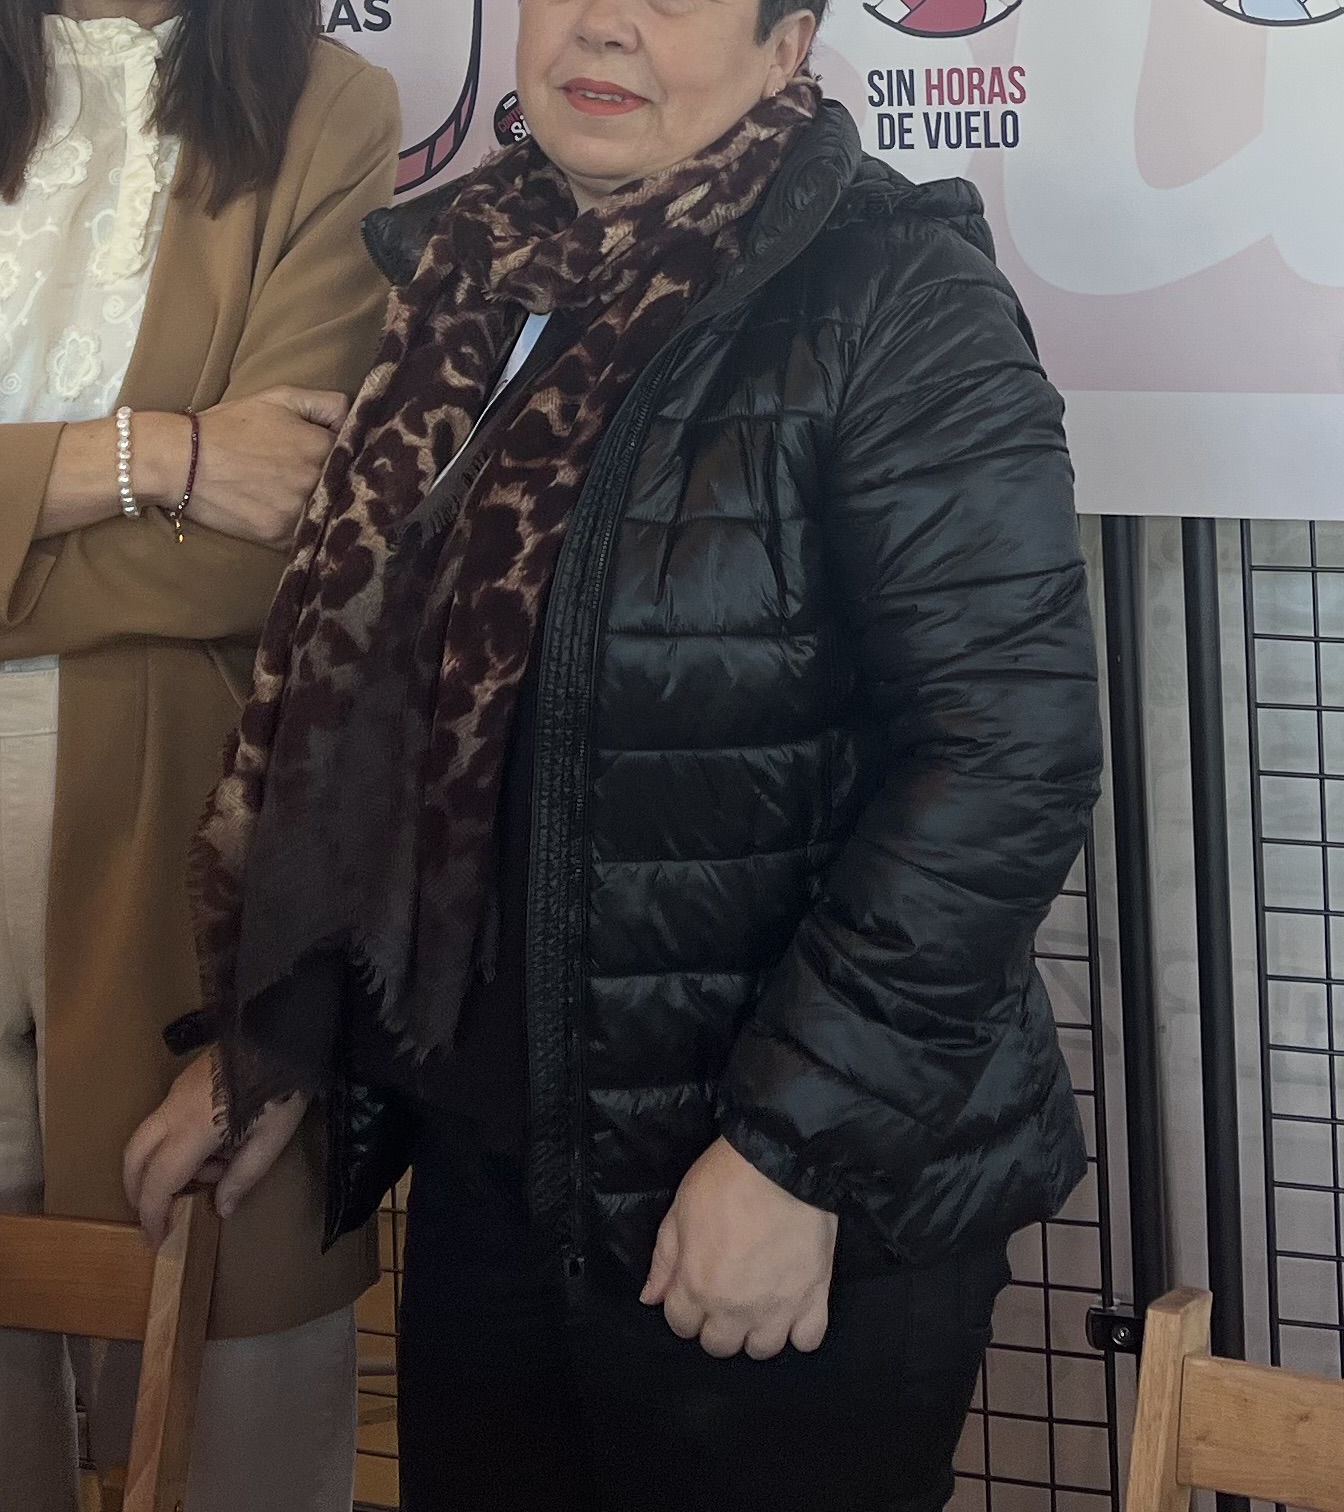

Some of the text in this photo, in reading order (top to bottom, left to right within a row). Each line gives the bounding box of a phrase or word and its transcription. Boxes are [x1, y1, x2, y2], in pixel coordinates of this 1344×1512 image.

[867, 65, 1026, 107] SIN HORAS
[877, 109, 1019, 150] DE VUELO
